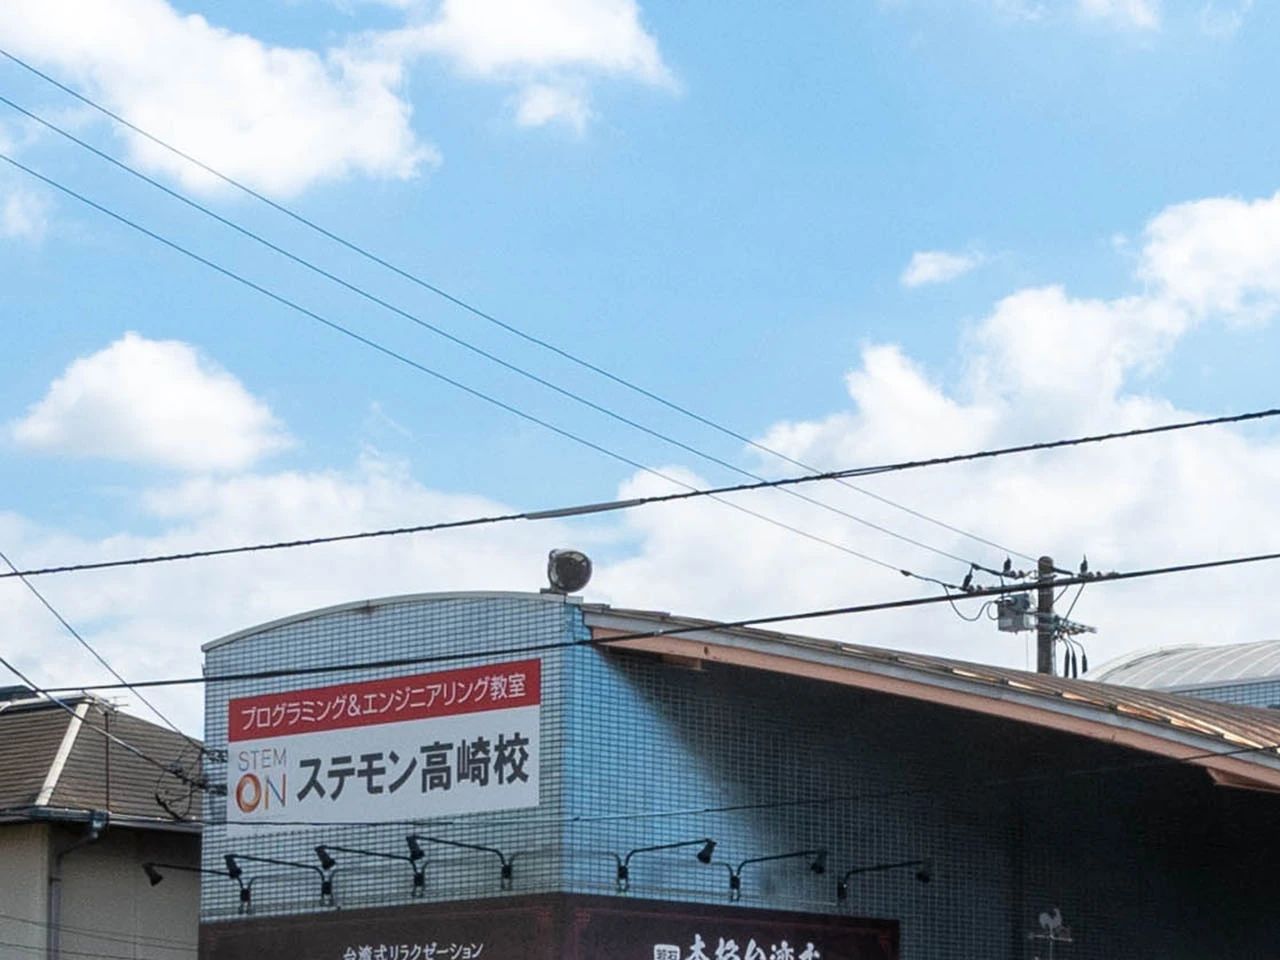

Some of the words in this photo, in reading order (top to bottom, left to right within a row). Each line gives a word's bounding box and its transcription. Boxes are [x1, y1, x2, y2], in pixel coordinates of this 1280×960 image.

[241, 673, 526, 731] プログラミング&エンジニアリング教室
[238, 747, 287, 772] STEM
[296, 732, 530, 803] ステモン高崎校
[235, 773, 287, 813] ON
